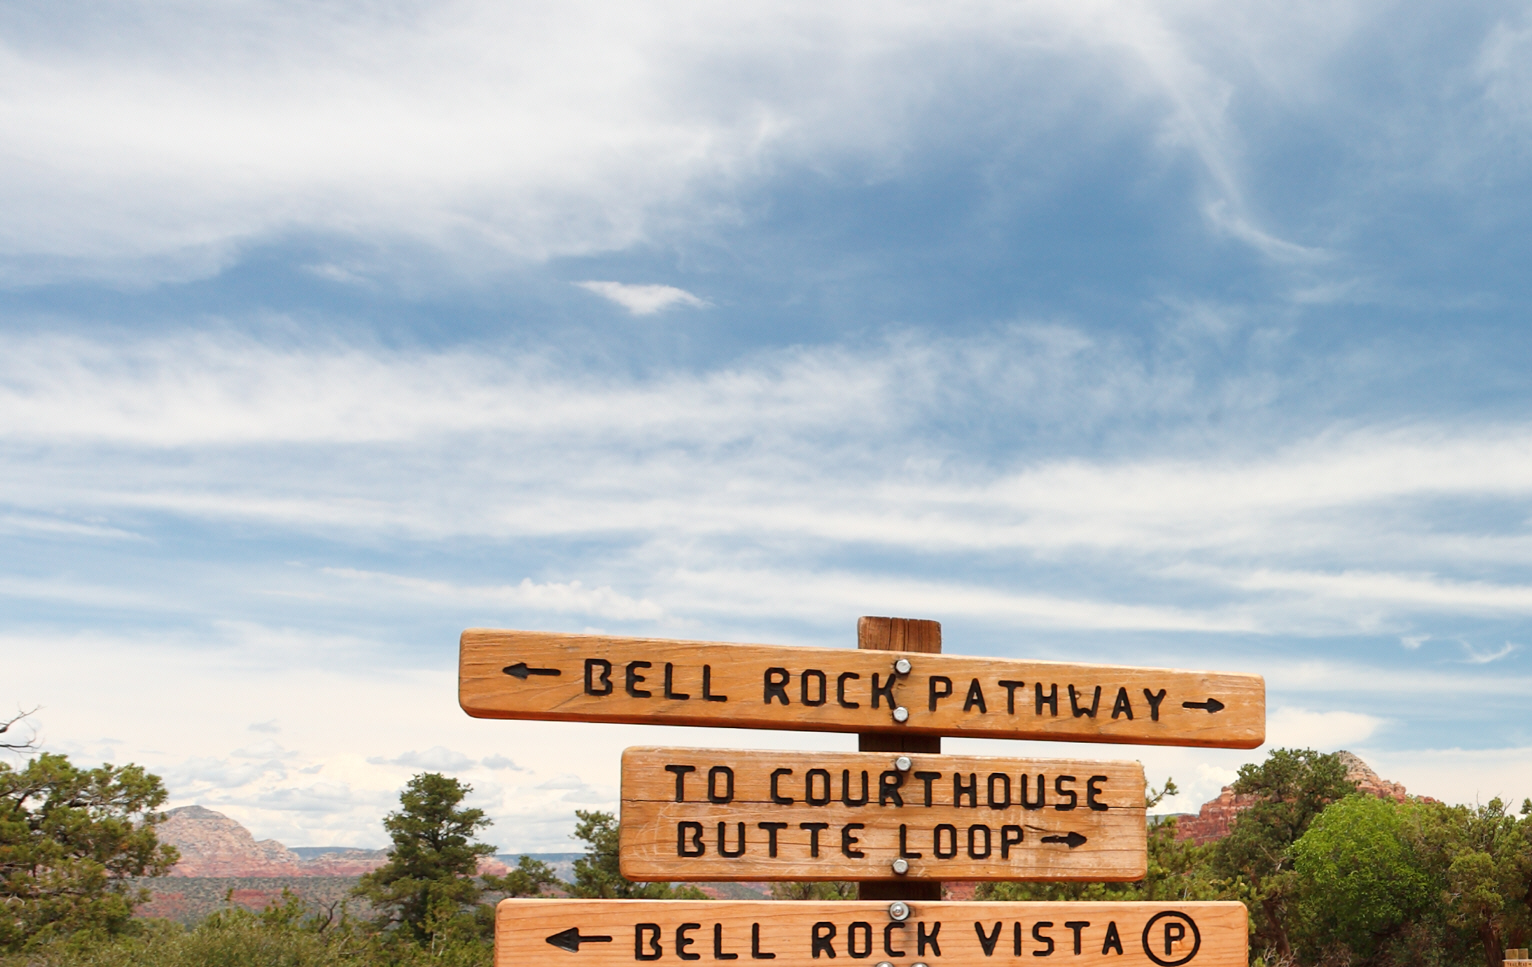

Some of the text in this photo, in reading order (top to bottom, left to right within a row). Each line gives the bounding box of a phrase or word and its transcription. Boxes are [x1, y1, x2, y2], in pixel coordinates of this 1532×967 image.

[585, 658, 1167, 721] BELL ROCK PATHWAY
[664, 764, 1109, 811] TO COURTHOUSE
[677, 821, 1024, 860] BUTTE LOOP
[634, 922, 776, 961] BELL
[811, 920, 942, 959] ROCK
[974, 920, 1124, 957] VISTA
